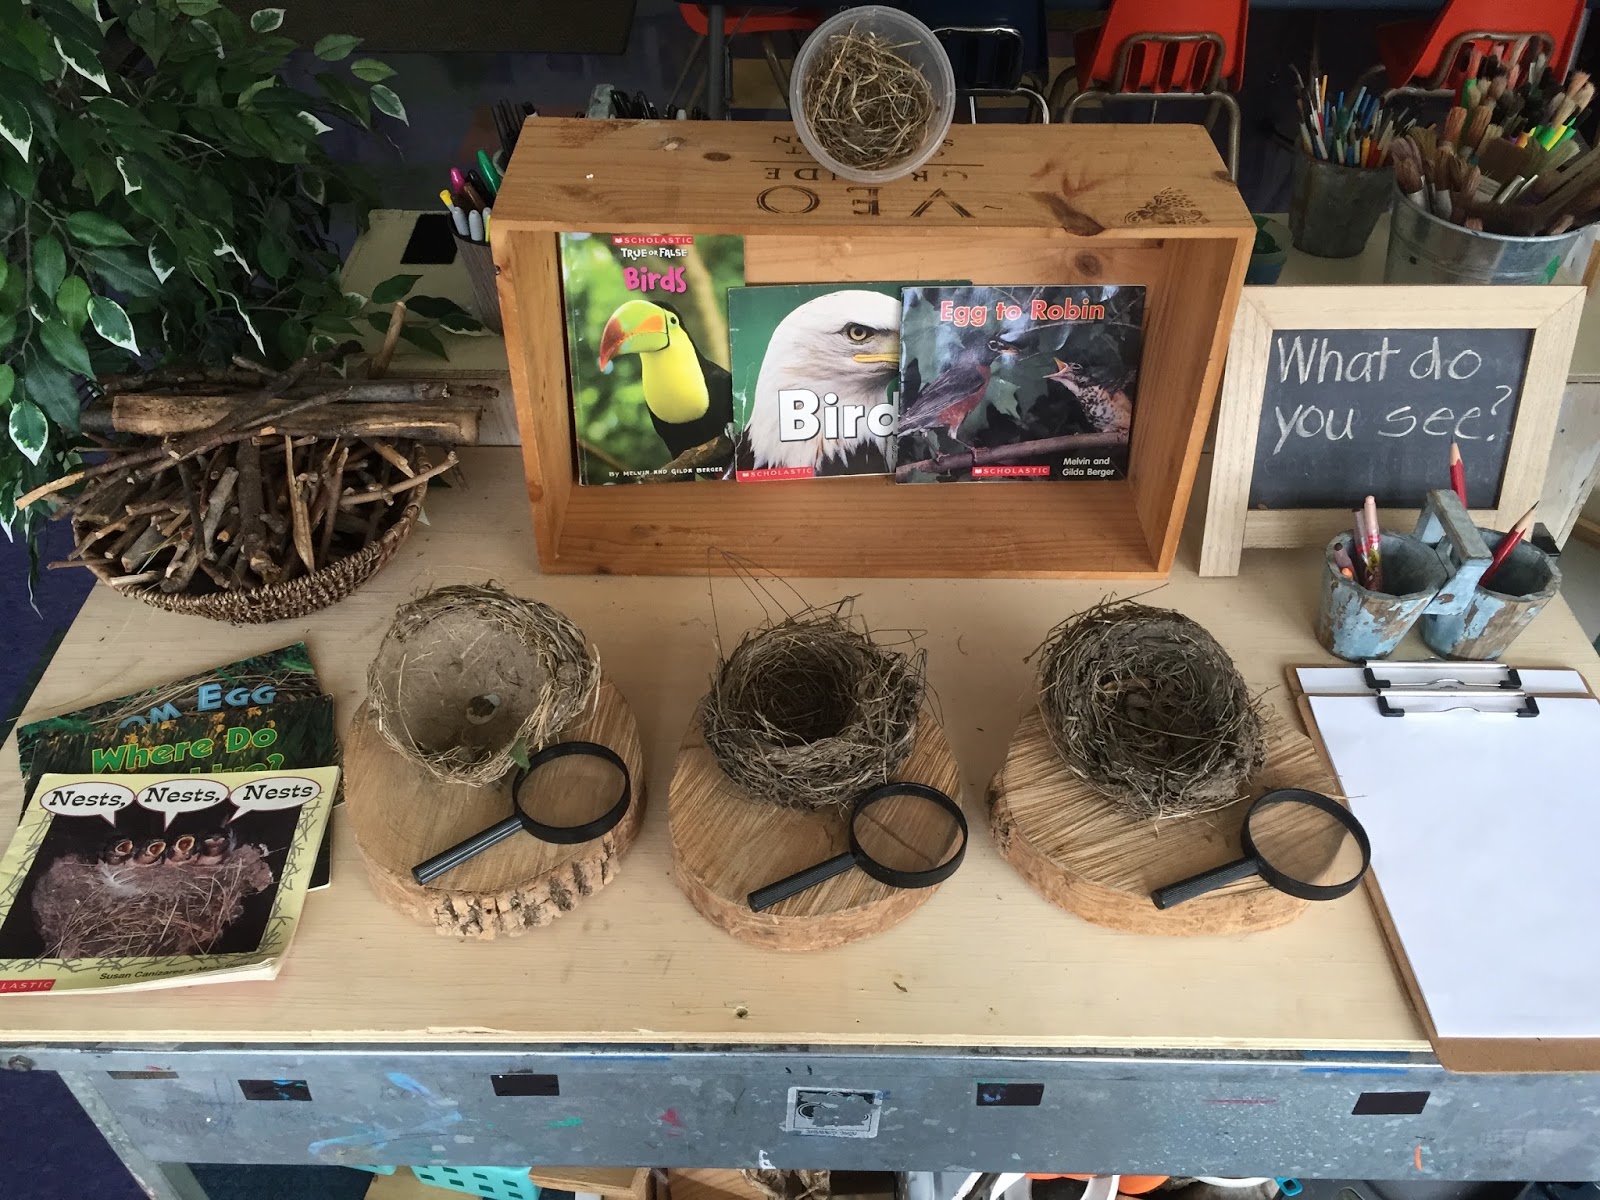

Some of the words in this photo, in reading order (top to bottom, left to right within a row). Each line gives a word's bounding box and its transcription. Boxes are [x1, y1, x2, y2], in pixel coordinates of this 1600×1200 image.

[623, 237, 693, 245] SCHOLASTIC
[621, 247, 648, 260] TRUE
[659, 247, 688, 258] FALSE
[623, 265, 687, 293] Birds
[940, 300, 988, 327] Egg
[996, 302, 1022, 321] to
[1030, 297, 1105, 321] Robin
[1277, 335, 1401, 385] What
[1409, 336, 1482, 380] do
[1273, 404, 1354, 456] you
[1377, 384, 1513, 442] see?
[1062, 457, 1091, 466] Melvin
[1093, 457, 1110, 465] and
[696, 466, 724, 474] BERGER
[750, 467, 813, 477] SCHOLASTIC
[983, 467, 1049, 475] SCHOLASTIC
[1062, 468, 1085, 477] Gilda
[1087, 468, 1115, 478] Berger
[91, 736, 214, 773] Where
[226, 726, 278, 754] Do
[49, 790, 127, 809] Nests,
[144, 787, 221, 805] Nests,
[242, 783, 314, 801] Nests
[99, 972, 132, 980] Susan
